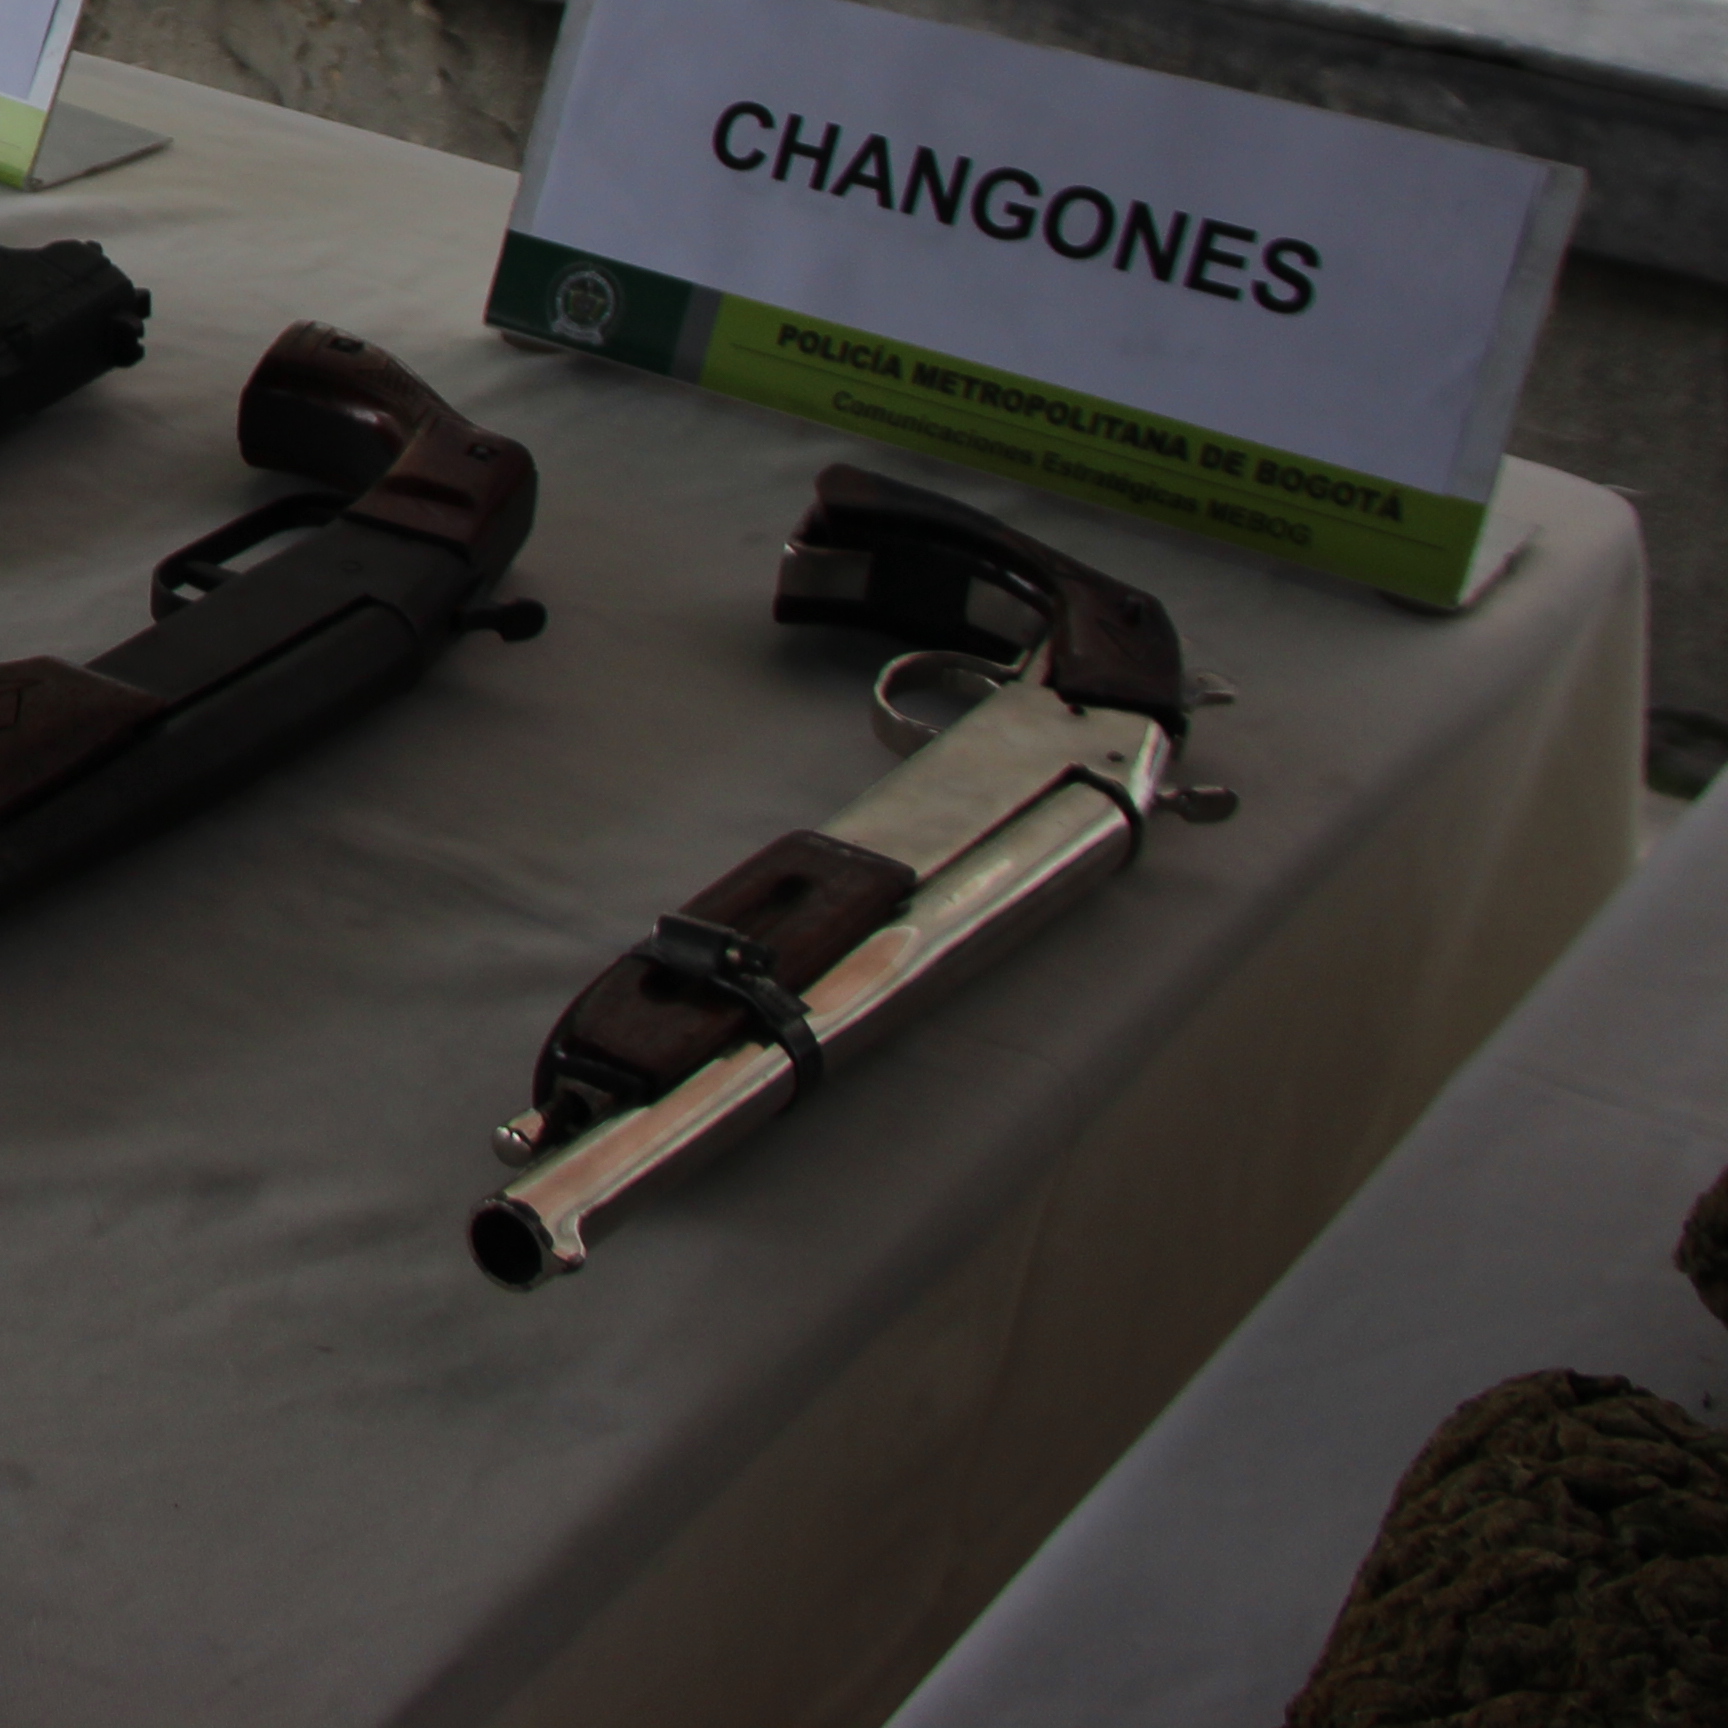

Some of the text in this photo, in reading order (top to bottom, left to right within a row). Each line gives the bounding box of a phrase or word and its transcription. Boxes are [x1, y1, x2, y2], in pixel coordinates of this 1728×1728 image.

[710, 99, 1322, 316] CHANGONES
[776, 323, 1404, 522] POLICÍA METROPOLITANA DE BOGOTÁ
[831, 390, 1035, 466] Comunicaciones
